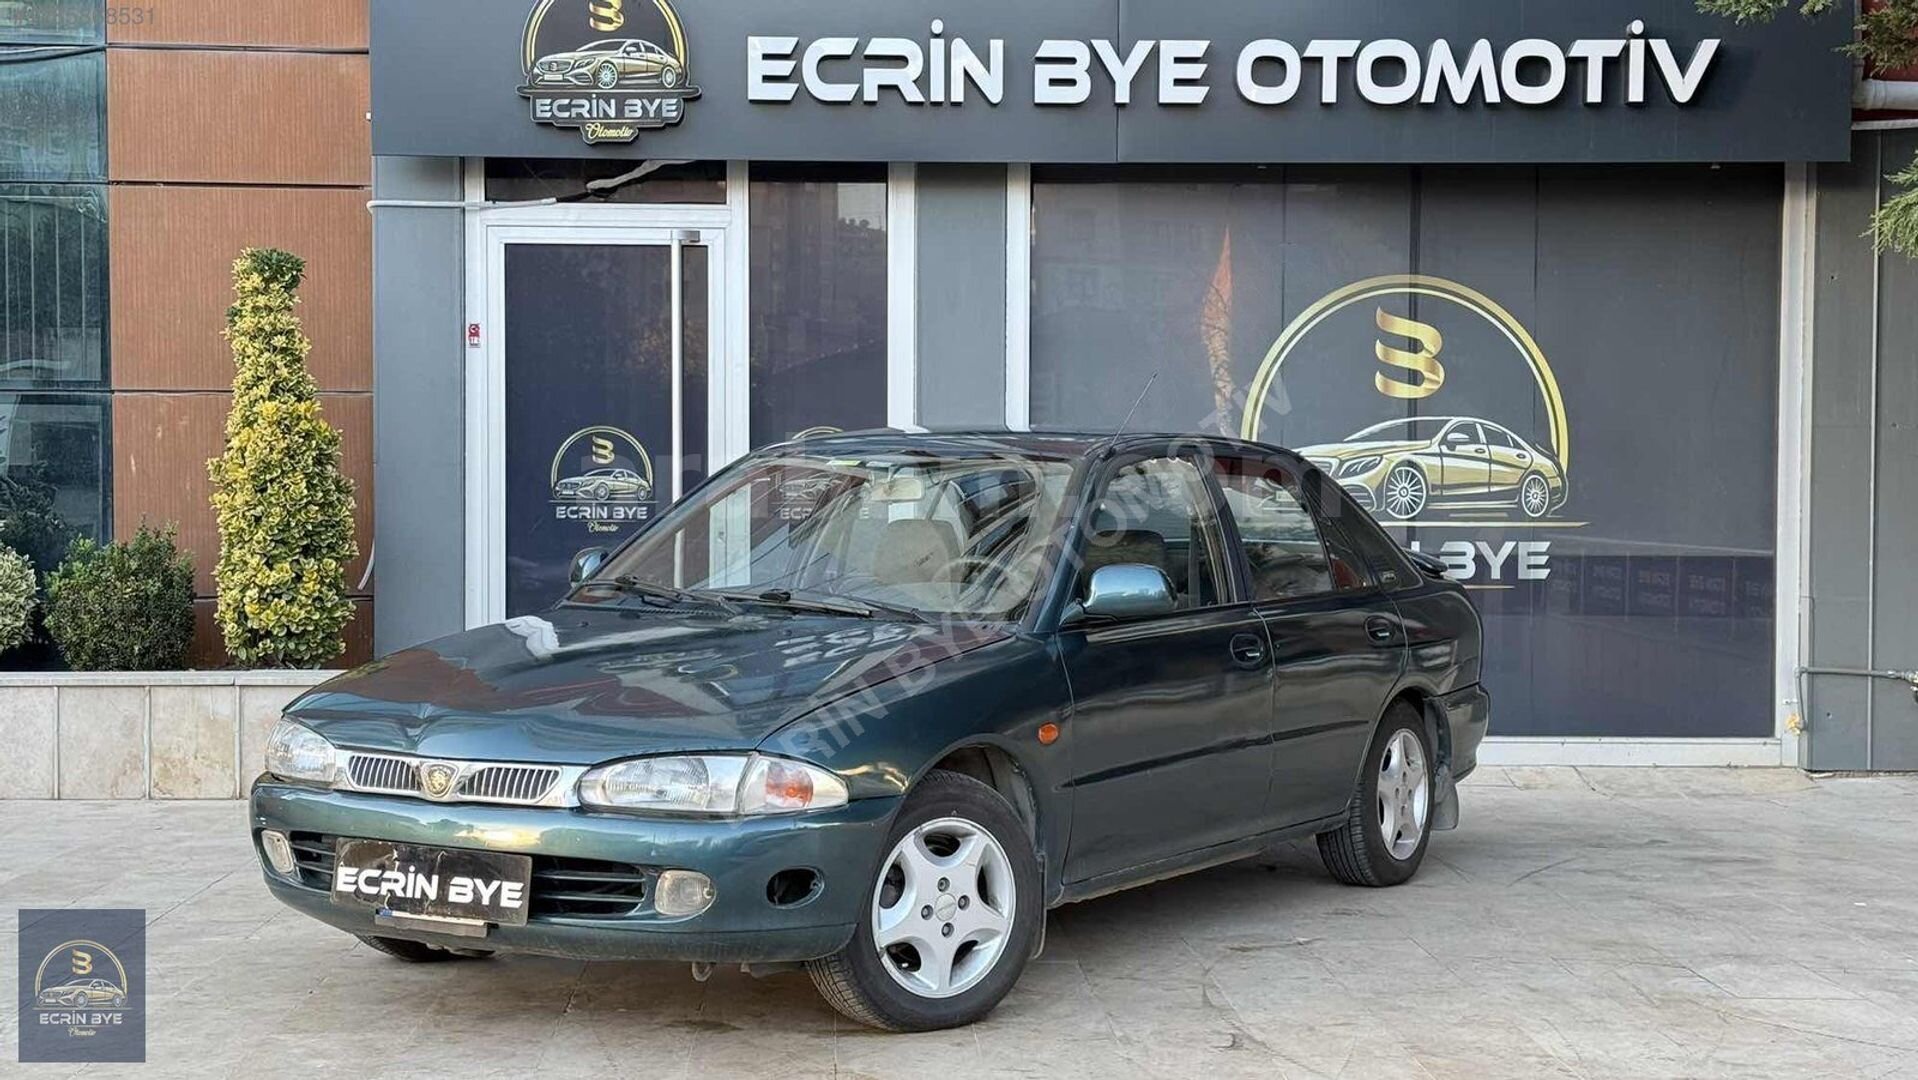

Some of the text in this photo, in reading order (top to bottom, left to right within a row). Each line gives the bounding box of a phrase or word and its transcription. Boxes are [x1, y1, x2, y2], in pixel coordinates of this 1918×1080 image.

[746, 18, 1721, 105] ECRİN BYE OTOMOTİV
[535, 93, 679, 118] ECRİN BYE
[555, 502, 648, 519] ECRİN BYE
[1439, 541, 1551, 580] BYE
[335, 864, 525, 909] ECRİN BYE
